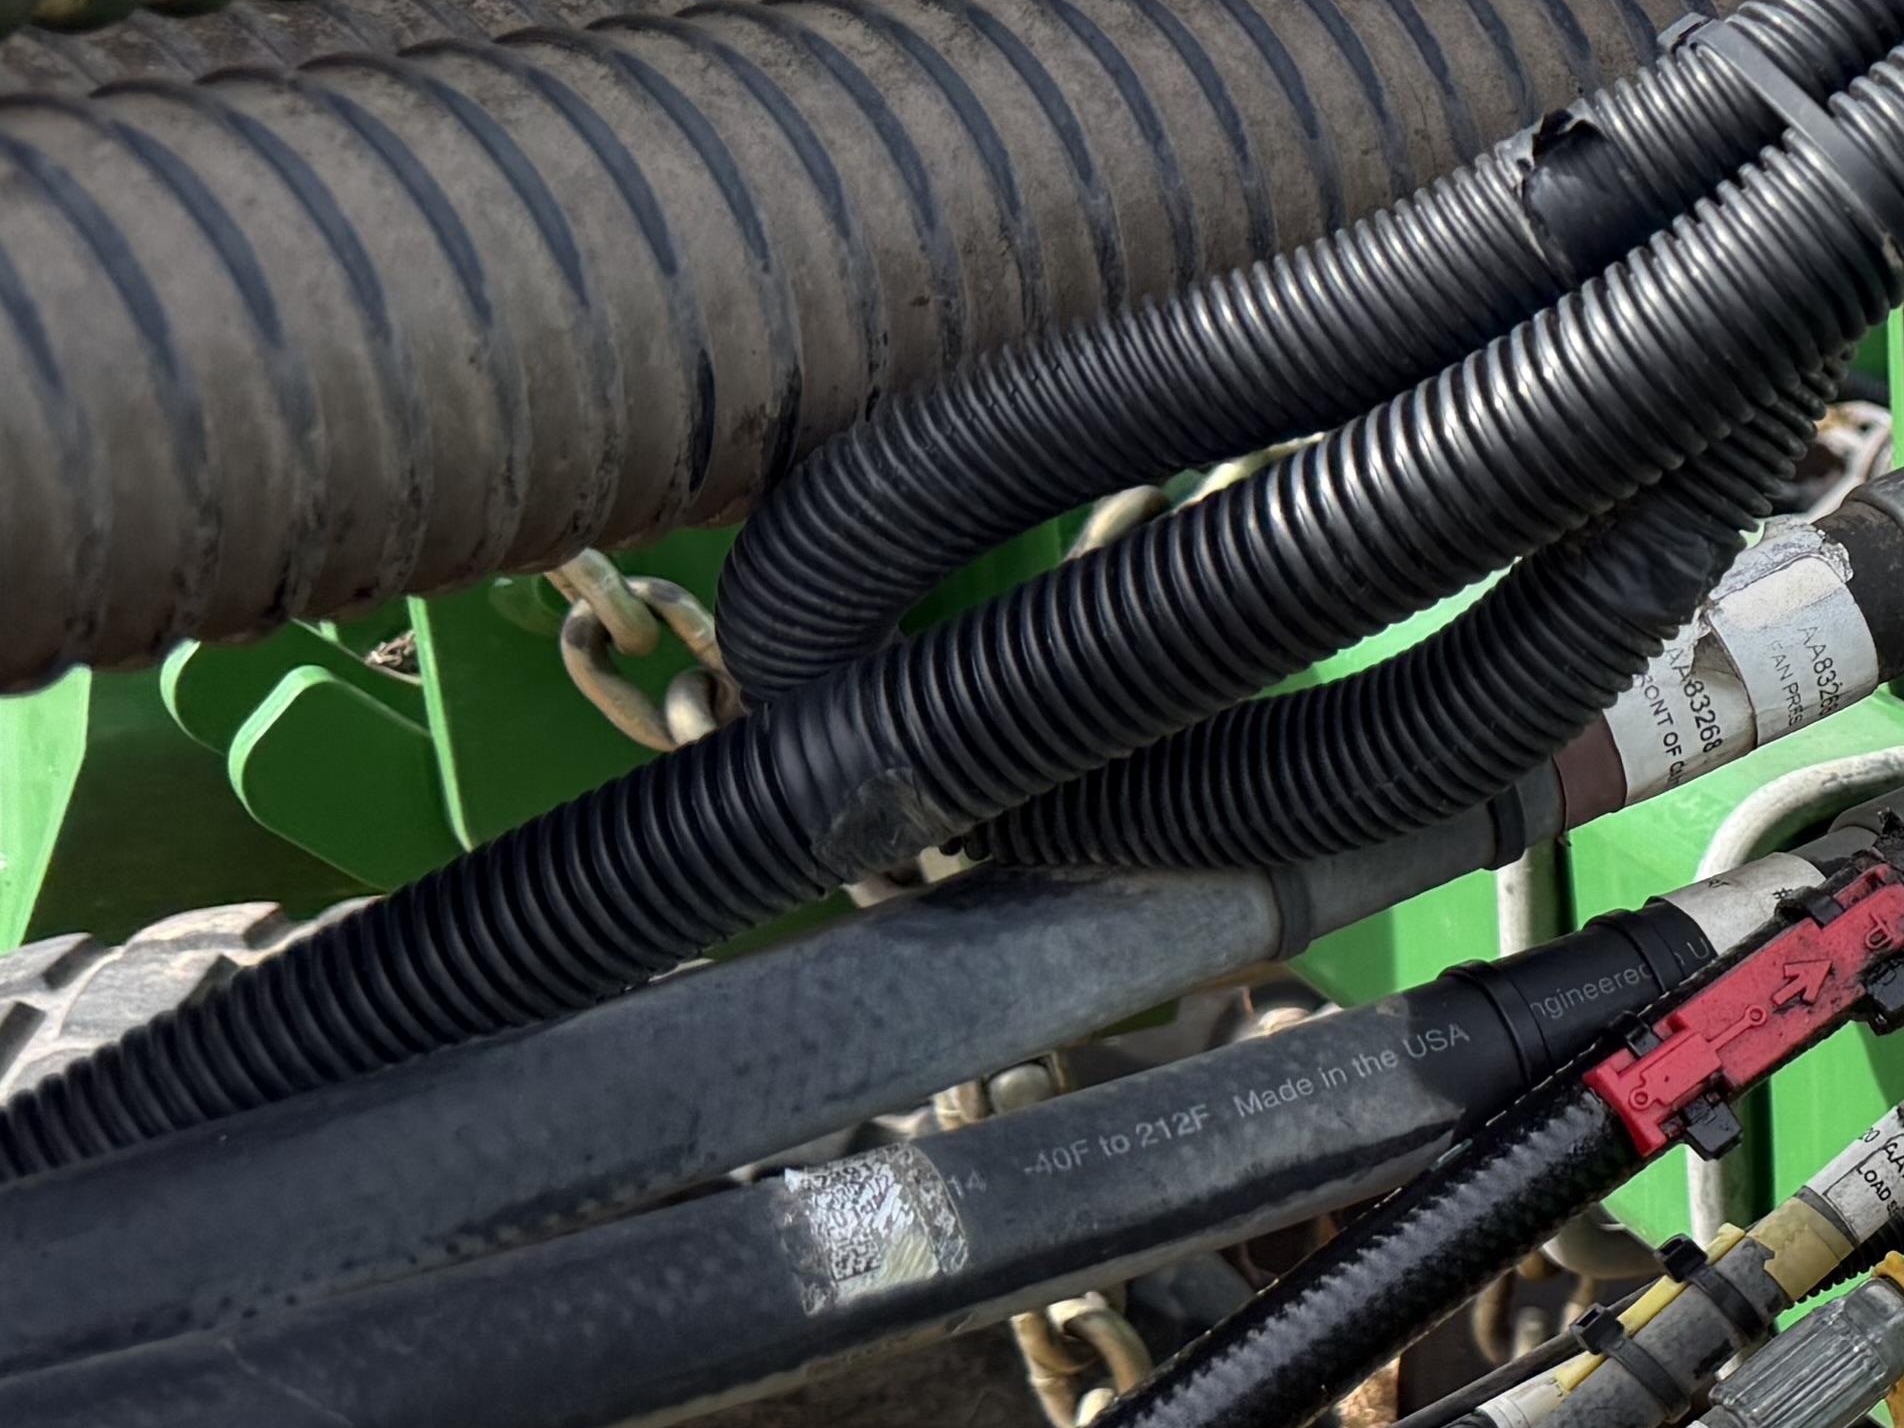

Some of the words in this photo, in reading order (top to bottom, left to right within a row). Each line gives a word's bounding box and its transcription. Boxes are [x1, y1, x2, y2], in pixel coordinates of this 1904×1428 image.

[1663, 644, 1726, 753] AA83268
[1660, 730, 1683, 758] OF
[1528, 956, 1651, 1020] ngineere
[1019, 1137, 1096, 1189] -40F
[1097, 1126, 1134, 1161] to
[1131, 1098, 1214, 1153] 212F
[1231, 1068, 1317, 1123] Made
[1315, 1057, 1350, 1092] in
[1349, 1040, 1400, 1081] the
[1402, 1015, 1472, 1063] USA
[1854, 1160, 1894, 1203] LOAD
